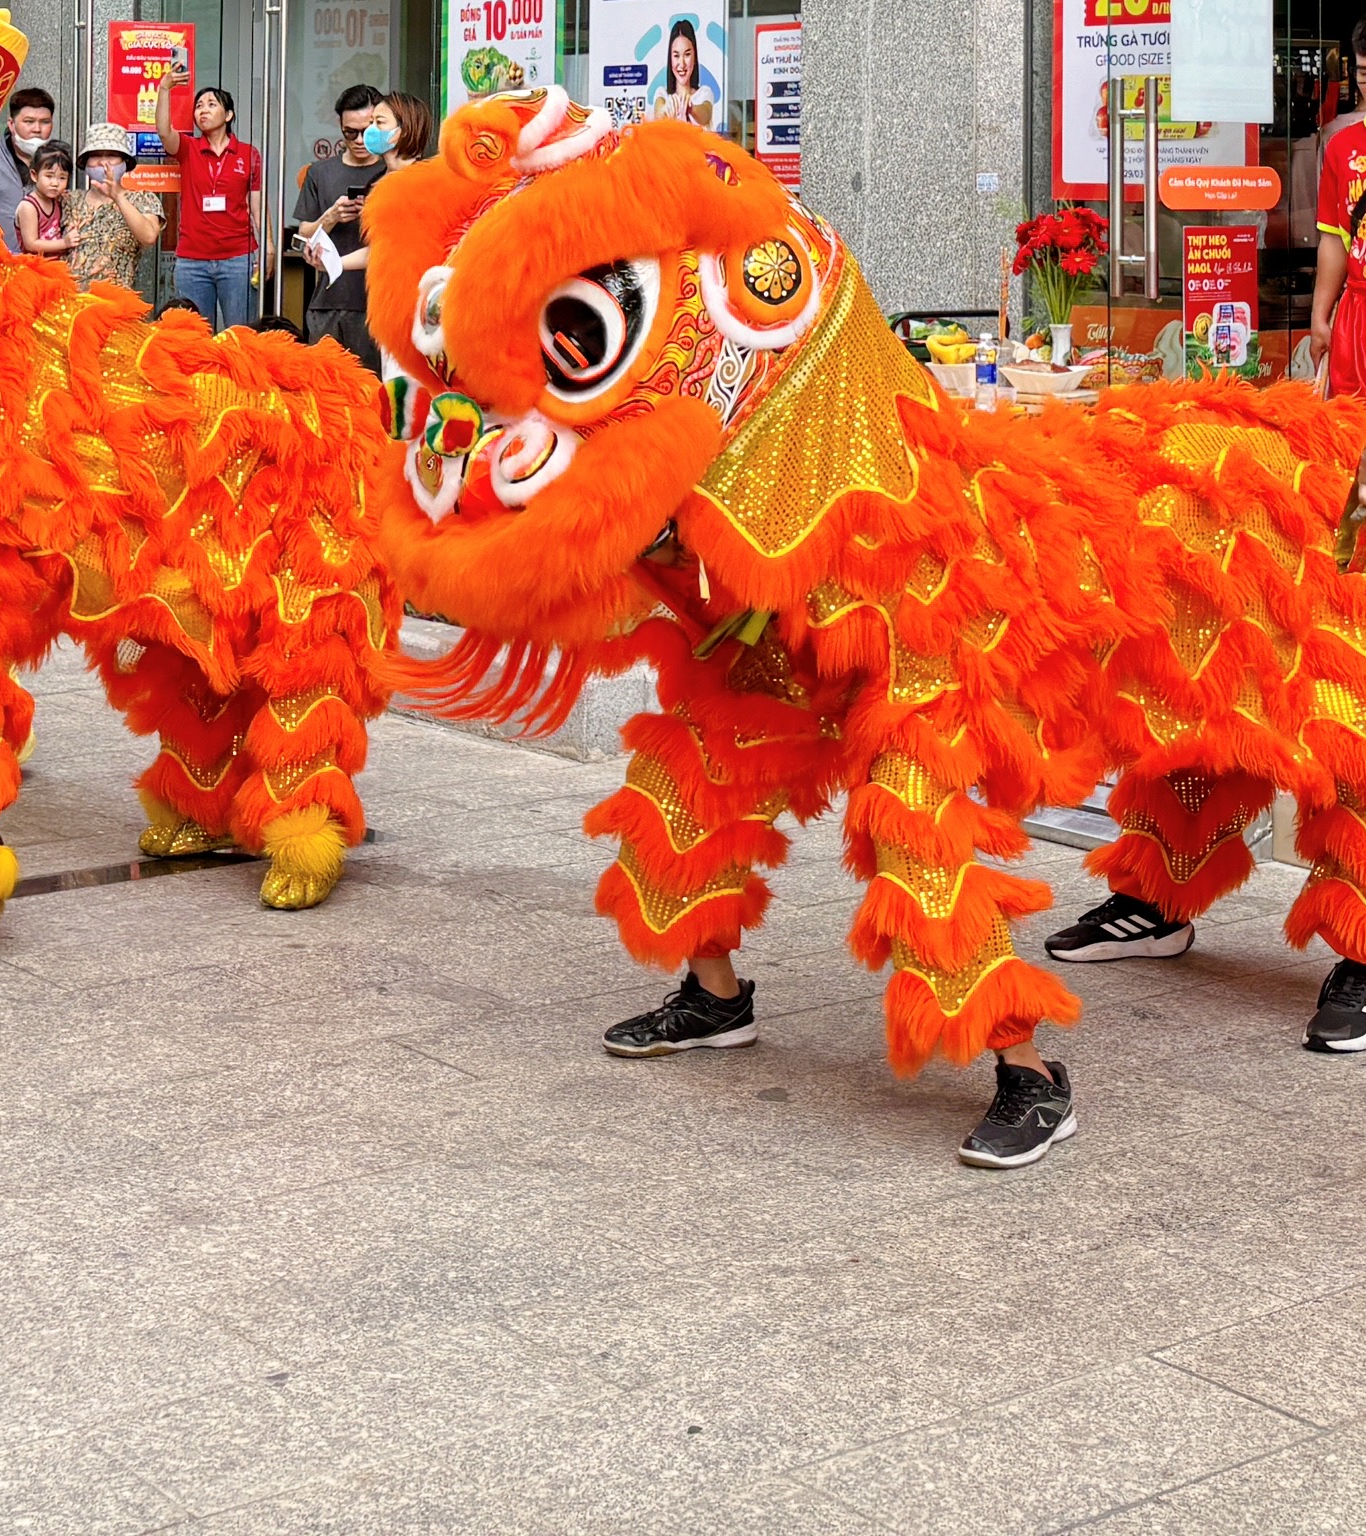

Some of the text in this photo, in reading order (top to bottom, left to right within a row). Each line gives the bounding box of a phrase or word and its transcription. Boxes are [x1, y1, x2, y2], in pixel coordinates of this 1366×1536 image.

[1077, 30, 1170, 49] TRỨNG GÀ TƯƠI
[1209, 235, 1227, 246] HEO
